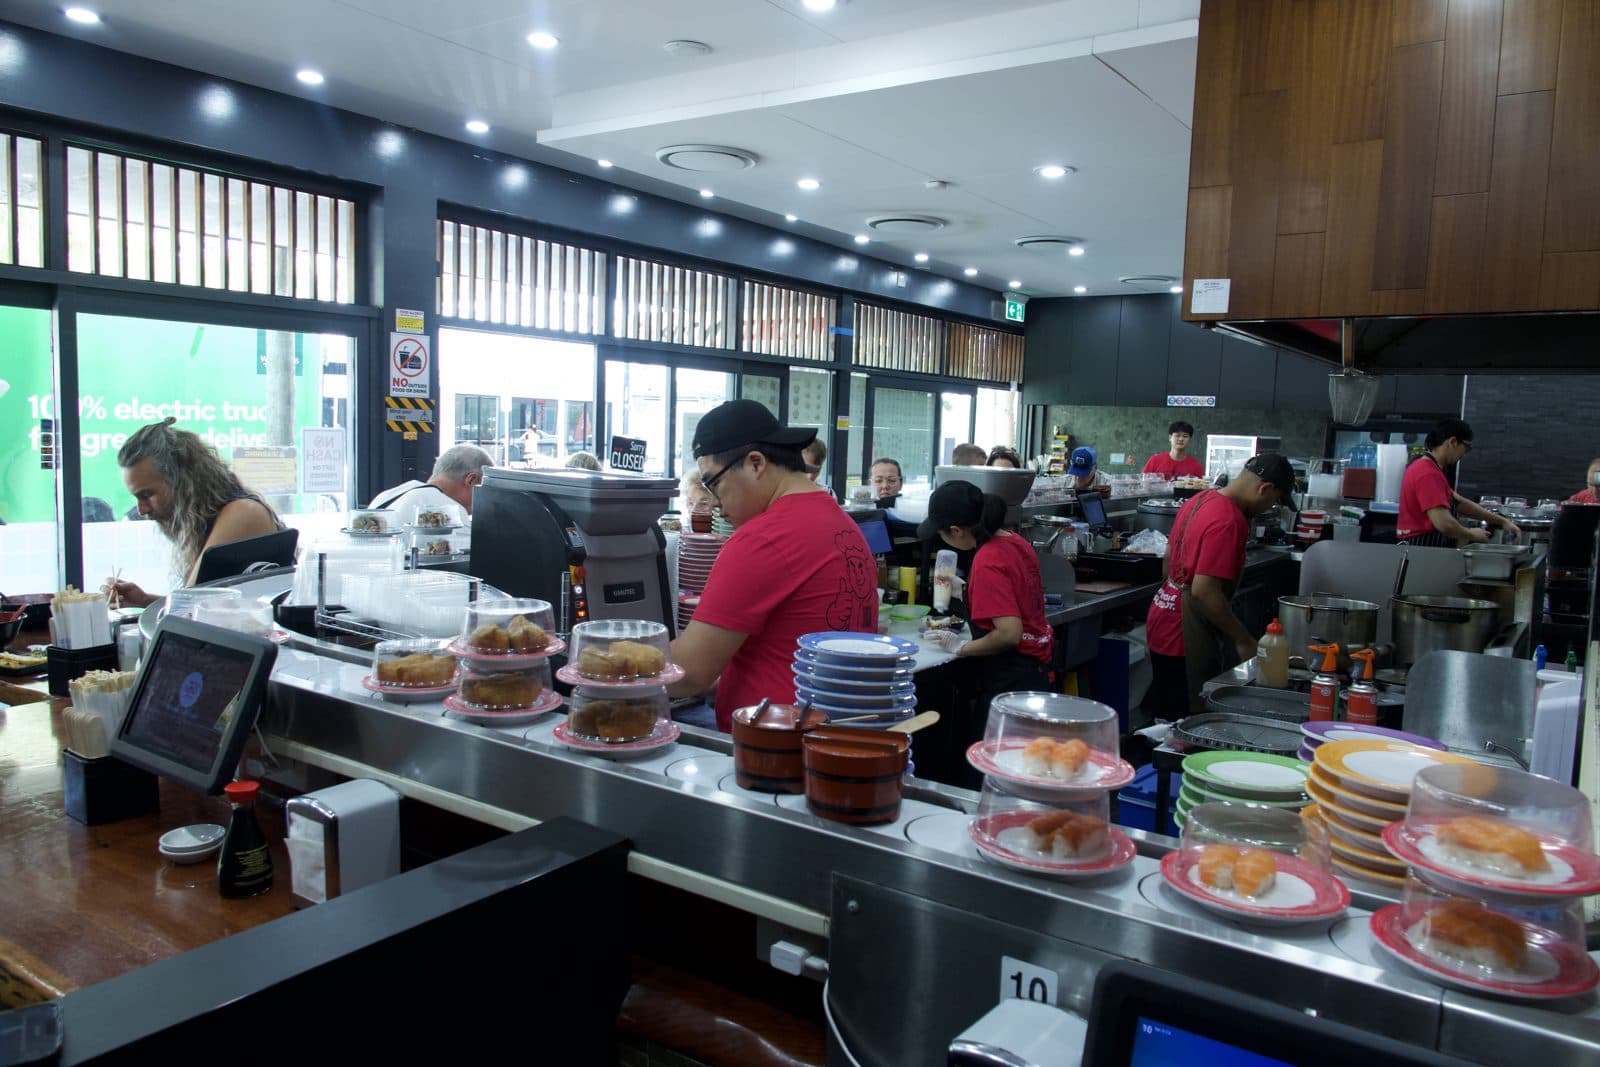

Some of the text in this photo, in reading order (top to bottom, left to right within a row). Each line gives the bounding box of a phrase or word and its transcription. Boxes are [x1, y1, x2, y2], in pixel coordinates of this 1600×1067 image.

[392, 377, 408, 387] NO
[28, 394, 267, 421] 10% electric truc
[630, 441, 645, 455] Sorry
[612, 451, 645, 470] CLOSED
[1010, 971, 1048, 1004] 10
